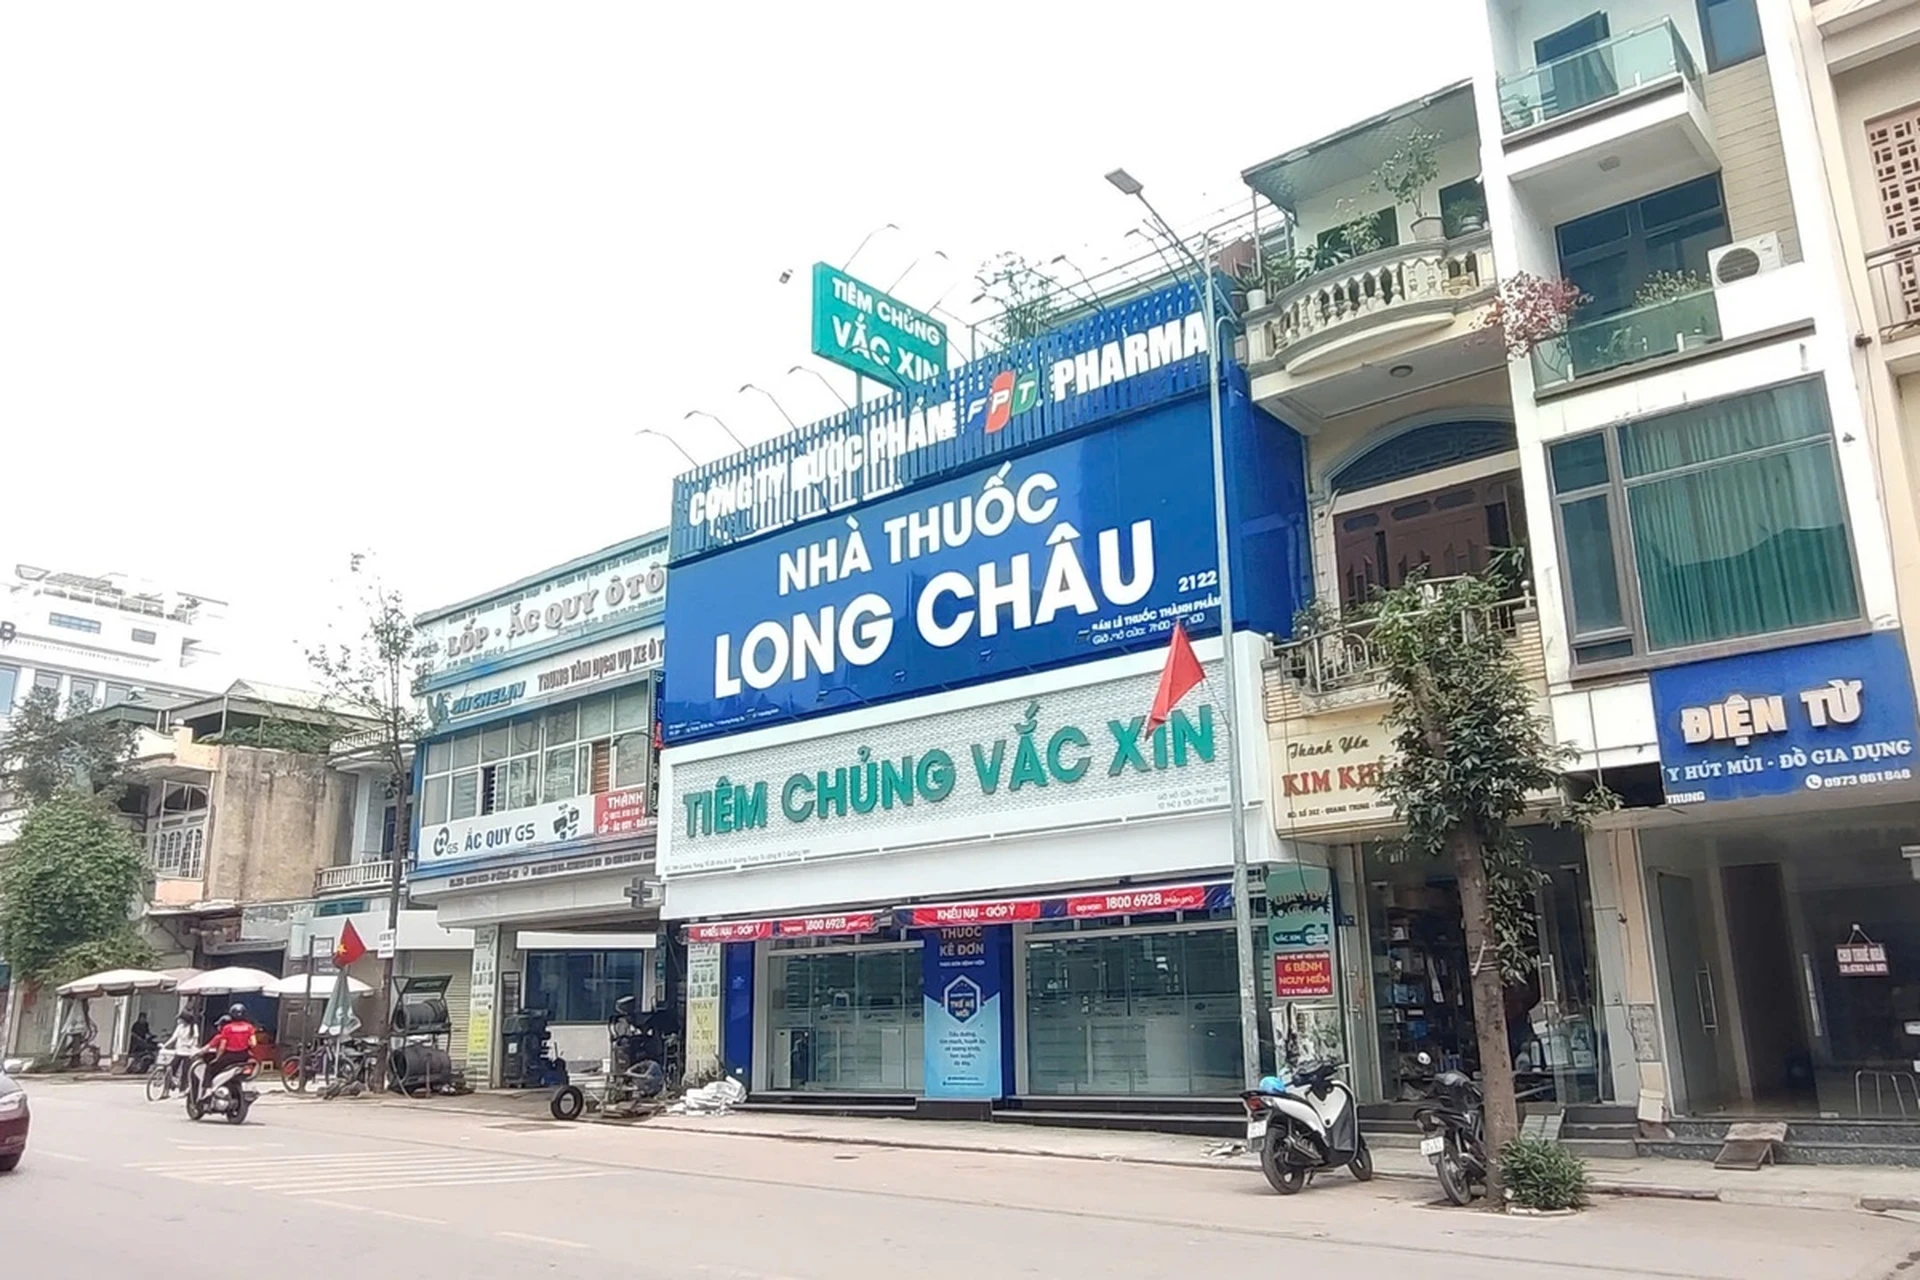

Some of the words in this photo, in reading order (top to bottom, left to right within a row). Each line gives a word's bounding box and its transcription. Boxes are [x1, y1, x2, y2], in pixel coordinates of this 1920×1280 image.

[831, 276, 873, 315] TIÊM
[876, 300, 941, 346] CHỦNG
[831, 312, 891, 367] VẮC
[896, 346, 940, 387] XIN
[689, 474, 754, 527] CÔNG
[753, 461, 787, 511] TY
[790, 430, 863, 492] ĐƯỢC
[868, 397, 957, 462] PHẨM
[966, 372, 1040, 429] FPT
[1052, 311, 1208, 402] PHARMA
[779, 515, 872, 596] NHÀ
[884, 461, 1058, 565] THUỐC
[1178, 570, 1217, 592] 2122
[447, 617, 489, 658] LỐP
[506, 603, 541, 639] ẮC
[544, 589, 599, 630] QUY
[605, 561, 665, 607] ÔTÔ
[714, 592, 894, 699] LONG
[916, 520, 1156, 647] CHÂU
[451, 681, 527, 713] MICHELIN
[538, 667, 569, 691] TRUNG
[633, 643, 648, 665] XE
[1681, 693, 1788, 747] ĐIỆN
[1800, 678, 1864, 727] TỪ
[1286, 740, 1333, 759] Thành
[1685, 758, 1722, 779] HÚT
[1727, 752, 1763, 775] MÙI
[1779, 747, 1808, 769] ĐỒ
[1811, 748, 1849, 765] GIA
[1852, 740, 1912, 763] DỤNG
[683, 775, 768, 838] TIÊM
[781, 745, 956, 823] CHỦNG
[970, 701, 1092, 795] VẮC
[1107, 704, 1216, 777] XIN
[1282, 769, 1332, 797] KIM
[607, 791, 644, 809] THÀNH
[1666, 791, 1705, 804] TRUNG
[464, 827, 482, 851] ẮC
[486, 827, 512, 848] QUY
[515, 823, 535, 841] GS
[937, 904, 961, 920] KHIẾU
[963, 908, 979, 921] NẠI
[986, 905, 1008, 917] GÓP
[1105, 896, 1131, 910] 1800
[1133, 893, 1162, 907] 6928
[940, 942, 955, 957] KÊ
[957, 942, 984, 956] ĐƠN
[1285, 963, 1291, 972] 6
[1293, 960, 1323, 972] BỆNH
